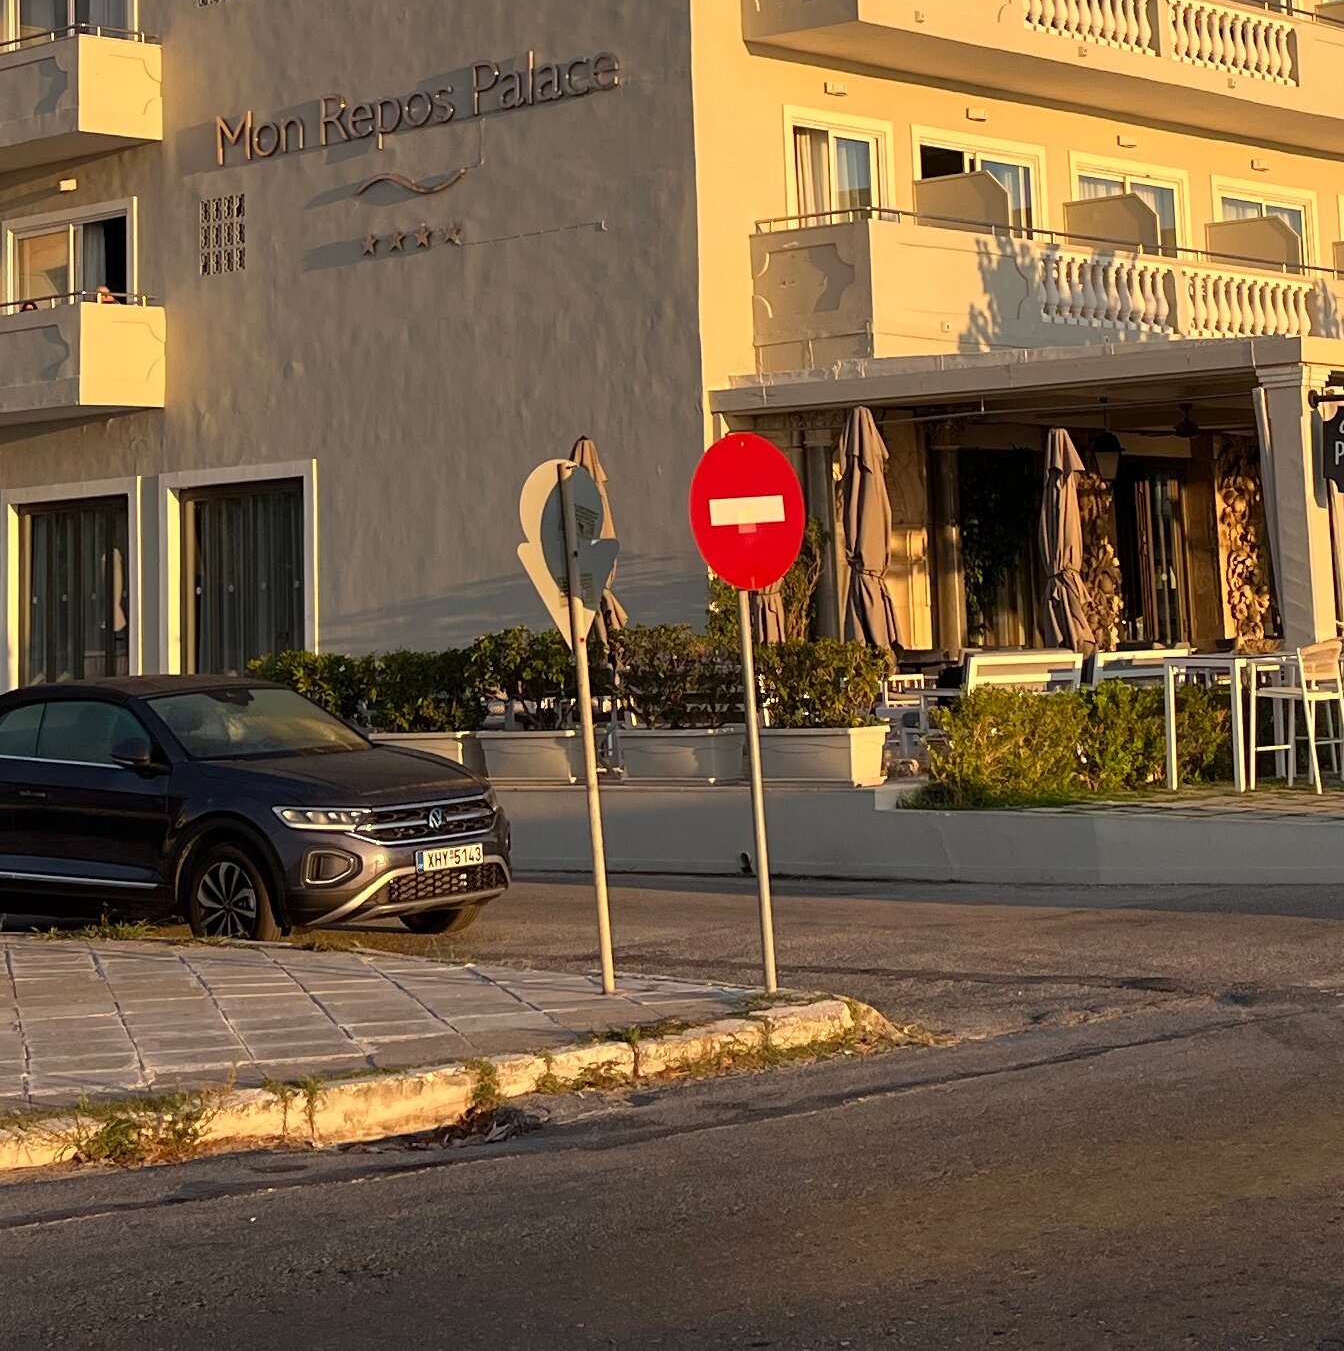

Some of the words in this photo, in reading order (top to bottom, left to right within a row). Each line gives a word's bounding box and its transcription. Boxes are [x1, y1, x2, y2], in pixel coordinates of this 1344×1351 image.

[216, 109, 304, 166] Mon
[319, 85, 455, 150] Repos
[471, 50, 620, 116] Palace
